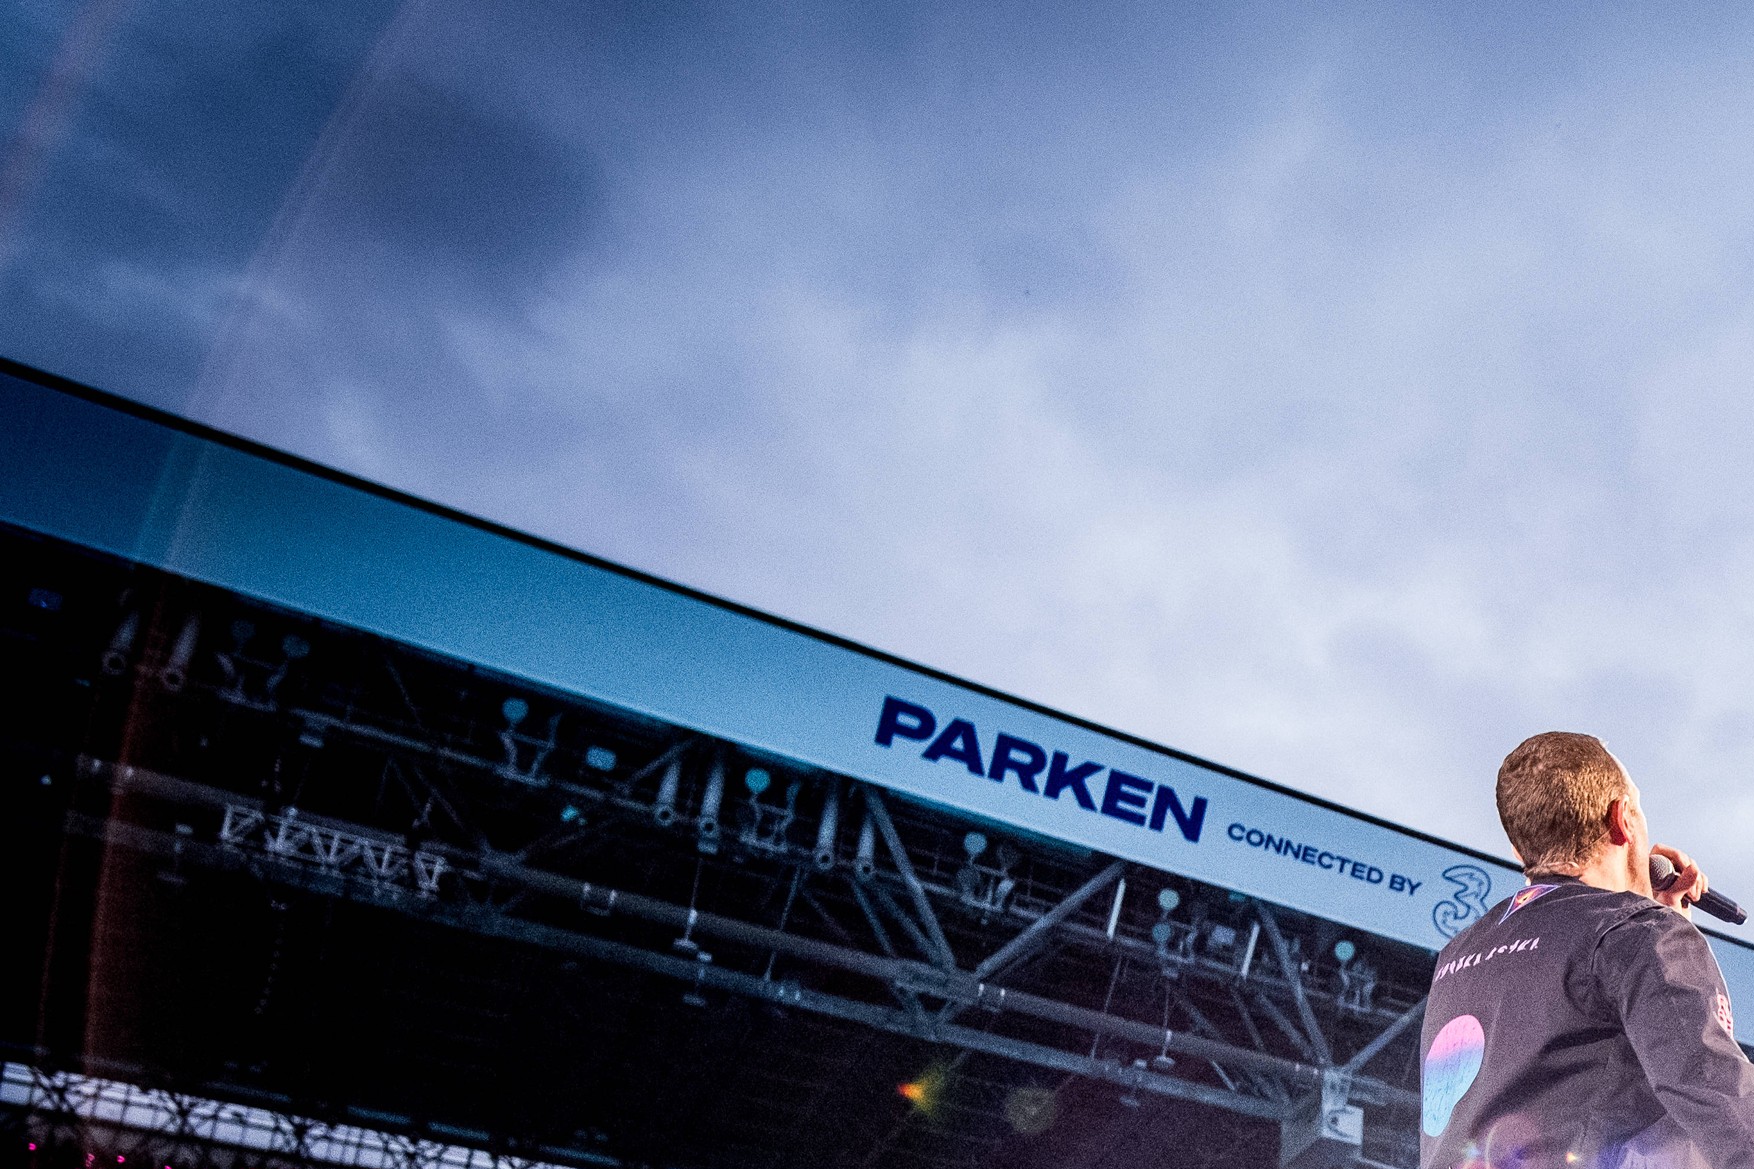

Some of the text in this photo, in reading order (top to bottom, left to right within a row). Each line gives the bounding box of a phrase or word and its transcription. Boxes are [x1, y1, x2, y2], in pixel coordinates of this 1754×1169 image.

[874, 695, 1208, 842] PARKEN
[1227, 822, 1383, 886] CONNECTED
[1389, 873, 1422, 897] BY
